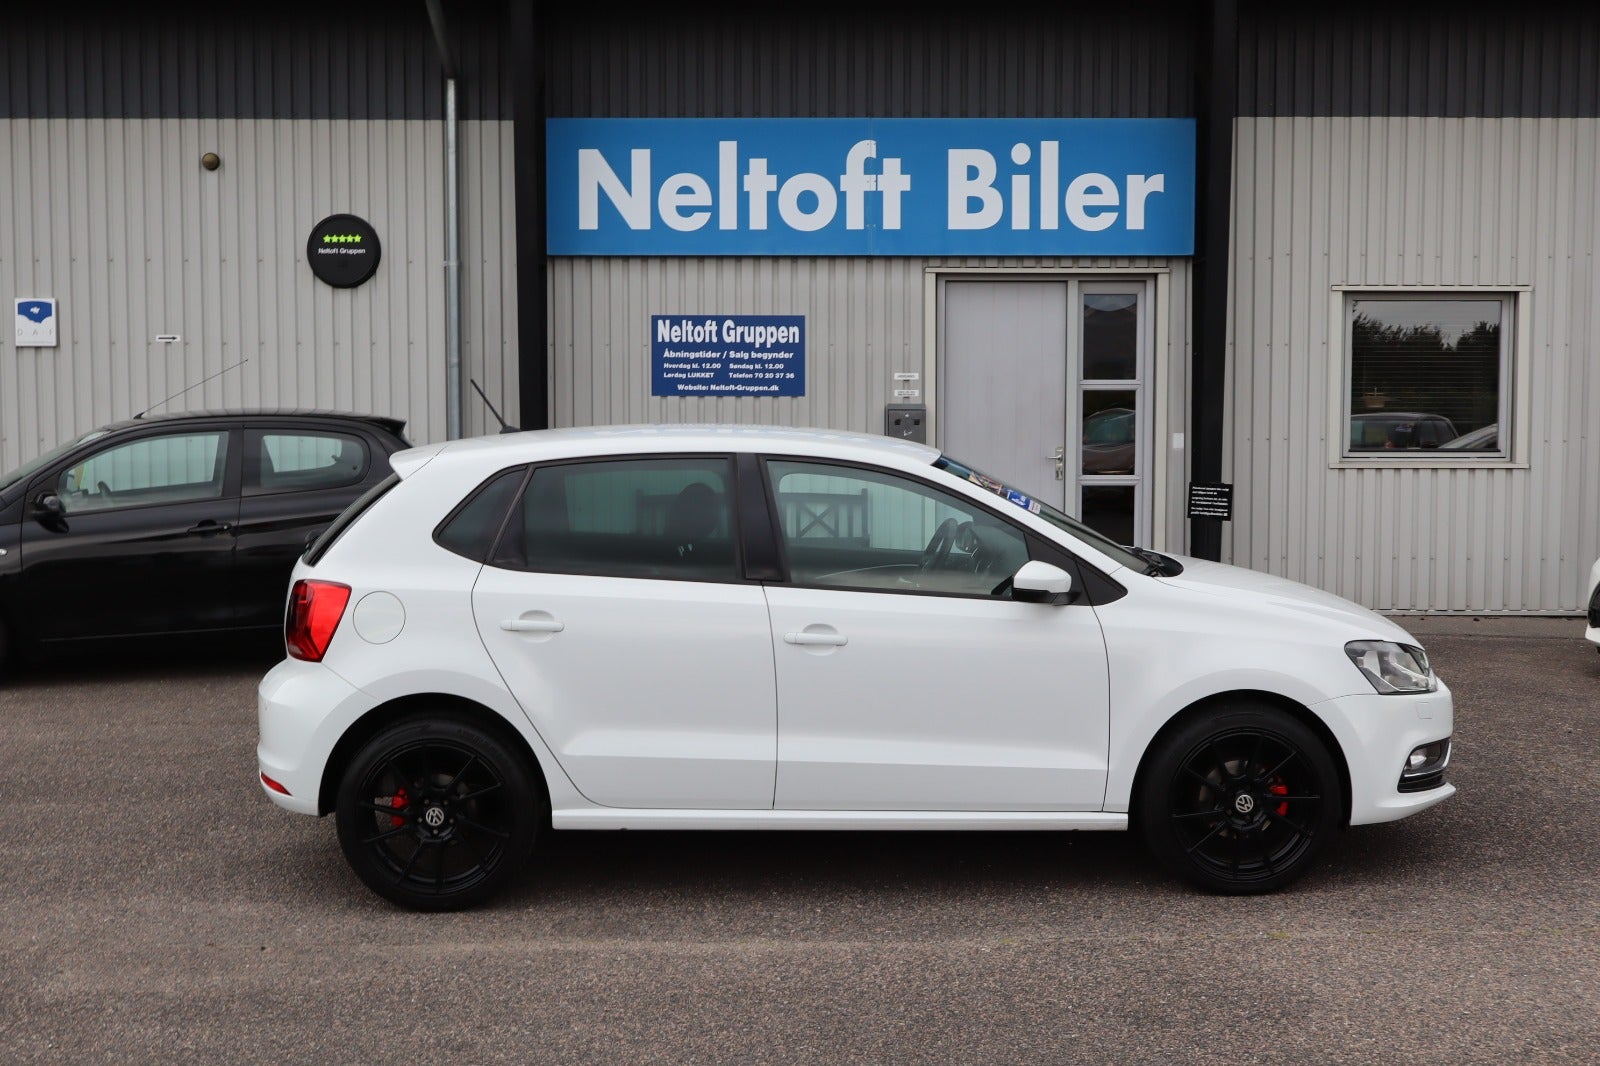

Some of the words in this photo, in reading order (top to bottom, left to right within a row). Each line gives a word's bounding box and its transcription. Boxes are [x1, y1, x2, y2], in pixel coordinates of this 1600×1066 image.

[578, 139, 911, 232] Neltoft
[947, 140, 1165, 232] Biler
[317, 247, 339, 255] Neltoft
[341, 247, 366, 256] Gruppen
[658, 320, 717, 342] Neltoft
[723, 320, 799, 348] Gruppen
[663, 348, 721, 359] Åbningstider
[729, 351, 749, 359] Salg
[751, 351, 793, 359] begynder
